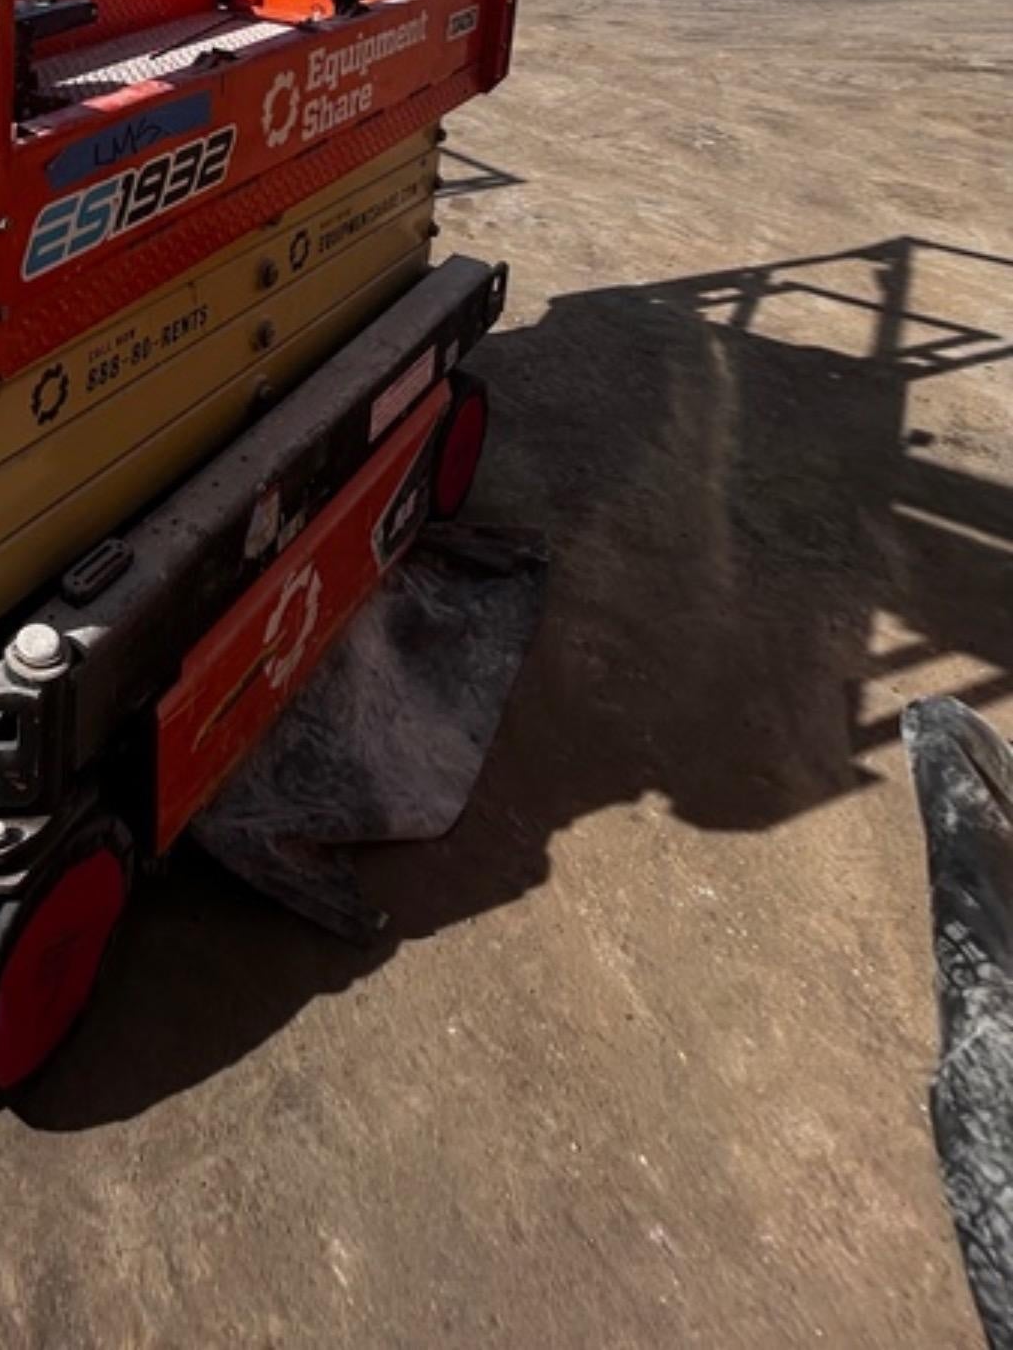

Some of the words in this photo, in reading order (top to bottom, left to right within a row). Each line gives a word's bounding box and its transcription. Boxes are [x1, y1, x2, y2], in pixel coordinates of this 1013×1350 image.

[305, 9, 428, 91] Equipment
[301, 82, 373, 141] Share
[22, 123, 237, 282] ES1932
